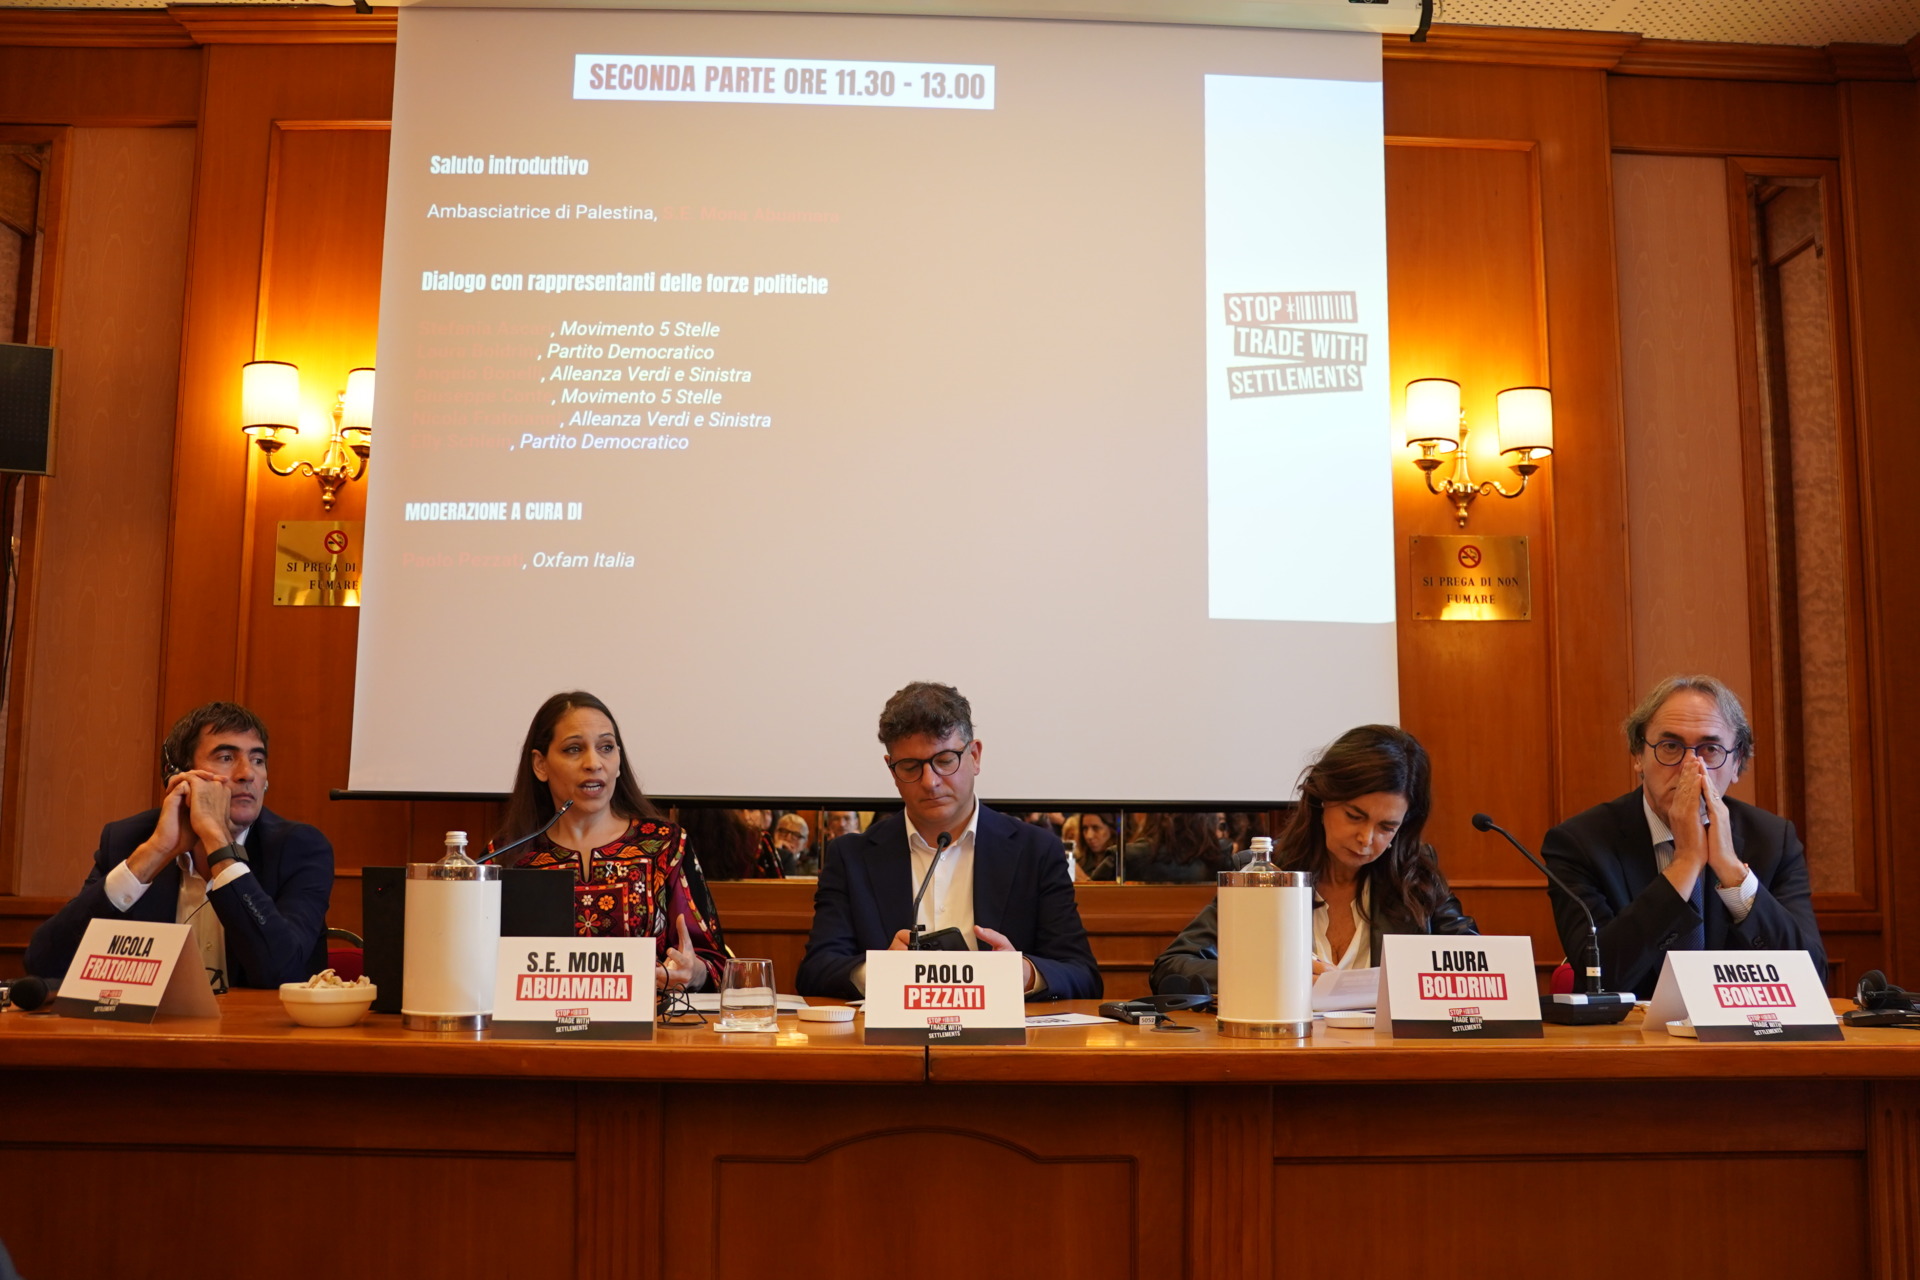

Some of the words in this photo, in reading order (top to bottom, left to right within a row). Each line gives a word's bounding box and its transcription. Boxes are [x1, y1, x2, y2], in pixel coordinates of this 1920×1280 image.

[589, 63, 696, 92] SECONDA
[704, 65, 776, 94] PARTE
[784, 67, 827, 95] ORE
[835, 69, 895, 97] 11.30
[920, 71, 985, 100] 13.00
[430, 155, 485, 175] Saluto
[488, 154, 589, 176] introduttivo
[427, 203, 551, 220] Ambasciatrice
[555, 203, 571, 220] di
[575, 204, 658, 223] Palestina,
[421, 270, 487, 293] Dialogo
[490, 272, 524, 292] con
[527, 271, 656, 294] rappresentanti
[660, 272, 702, 293] delle
[706, 273, 749, 293] forze
[753, 273, 829, 296] politiche
[1228, 295, 1282, 322] STOP
[560, 320, 655, 337] Movimento
[659, 321, 671, 337] 5
[673, 321, 721, 337] Stelle
[547, 343, 604, 359] Partito
[607, 343, 715, 360] Democratico
[1236, 326, 1305, 357] TRADE
[1310, 331, 1365, 362] WITH
[549, 365, 622, 382] Alleanza
[628, 366, 671, 382] Verdi
[674, 369, 685, 382] e
[688, 366, 752, 382] Sinistra
[1231, 364, 1360, 395] SETTLEMENTS
[560, 388, 656, 404] Movimento
[660, 388, 672, 404] 5
[675, 388, 722, 404] Stelle
[568, 410, 641, 426] Alleanza
[647, 411, 690, 427] Verdi
[693, 414, 705, 427] e
[708, 411, 772, 428] Sinistra
[519, 433, 577, 449] Partito
[581, 433, 689, 450] Democratico
[405, 502, 508, 521] MODERAZIONE
[510, 502, 521, 520] A
[525, 502, 563, 520] CURA
[567, 502, 583, 520] DI
[286, 562, 298, 572] SI
[303, 562, 339, 573] PREGA
[345, 562, 356, 572] DI
[532, 551, 589, 568] Oxfam
[593, 551, 636, 568] Italia
[309, 580, 359, 590] FUMARE
[1423, 576, 1433, 587] SI
[1439, 577, 1475, 587] PREGA
[1481, 577, 1492, 587] DI
[1497, 577, 1519, 588] NON
[1447, 594, 1496, 604] FUMARE
[107, 934, 154, 957] NICOLA
[83, 957, 160, 985] FRATOIANNI
[527, 951, 561, 973] S.E.
[568, 951, 625, 973] MONA
[1431, 950, 1489, 972] LAURA
[915, 964, 974, 984] PAOLO
[1713, 963, 1780, 983] ANGELO
[519, 976, 629, 1000] ABUAMARA
[1421, 975, 1504, 999] BOLDRINI
[1717, 986, 1792, 1006] BONELLI
[908, 987, 982, 1008] PEZZATI
